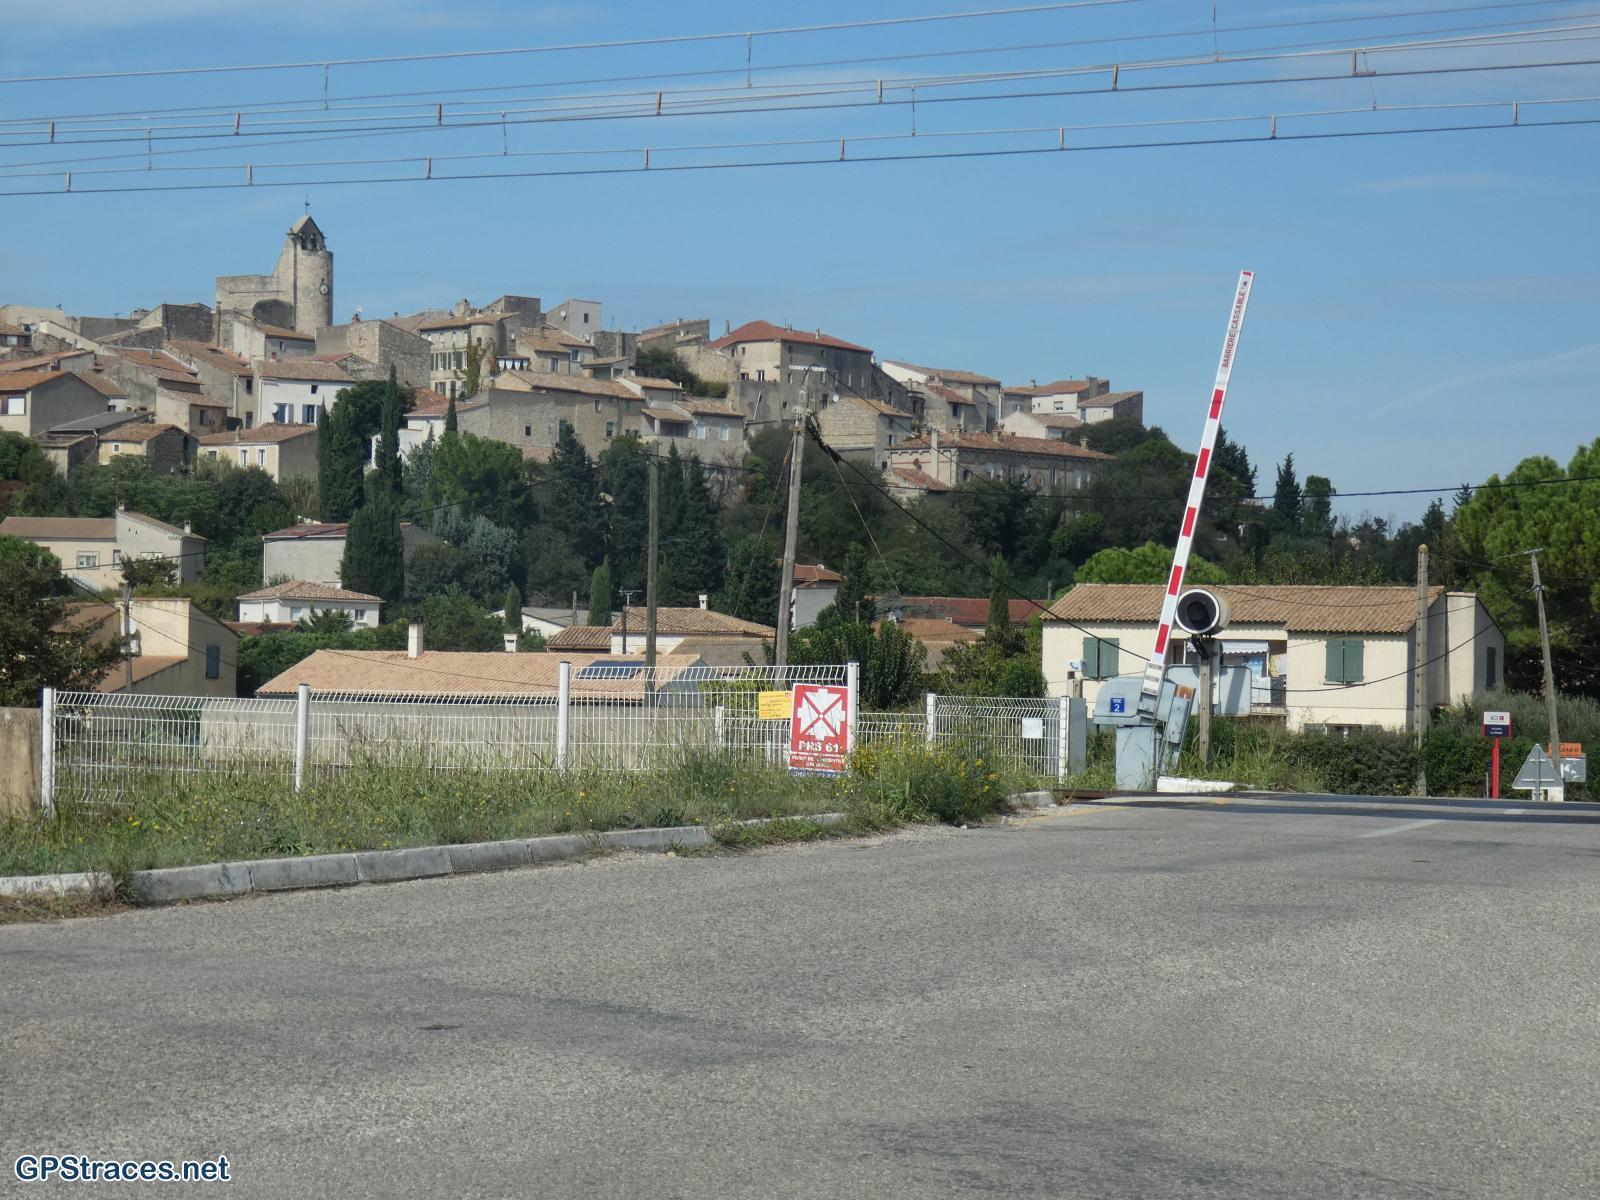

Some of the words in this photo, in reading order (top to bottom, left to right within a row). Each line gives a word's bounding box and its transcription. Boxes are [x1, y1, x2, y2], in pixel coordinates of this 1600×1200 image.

[1223, 333, 1235, 368] BARRIERE
[1232, 292, 1246, 329] CASSABLE
[1114, 703, 1120, 712] 2
[825, 742, 839, 753] 61
